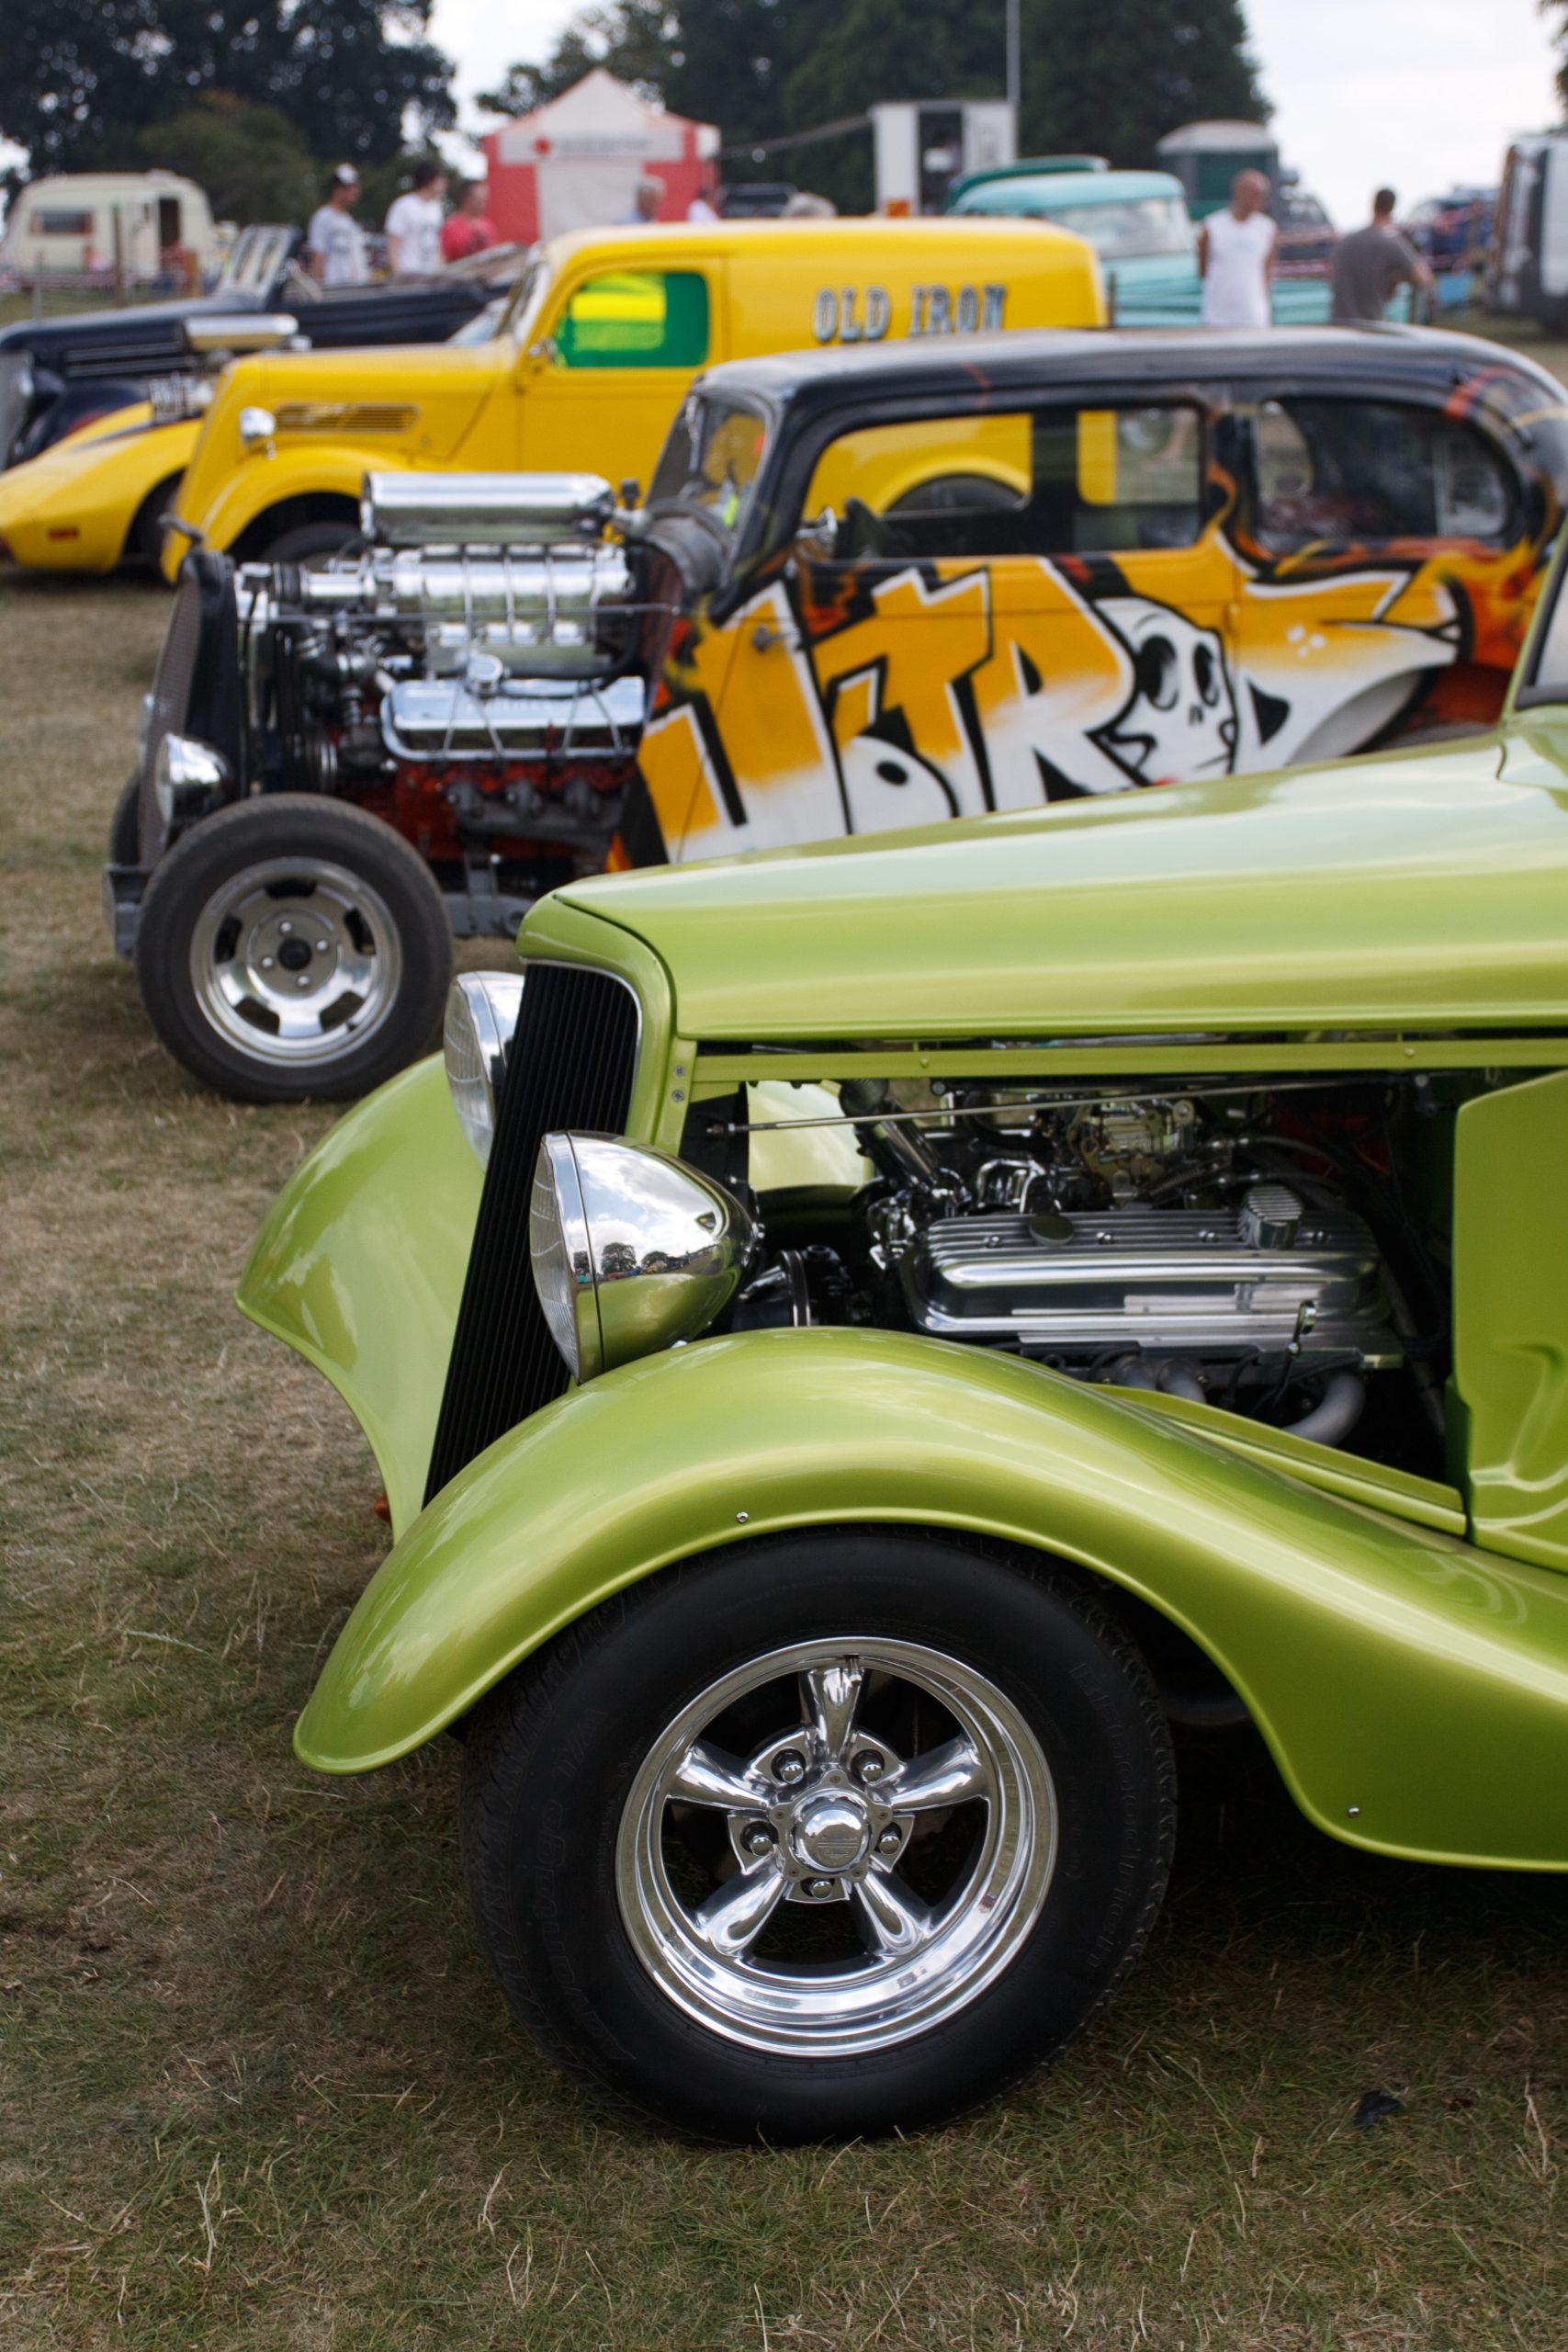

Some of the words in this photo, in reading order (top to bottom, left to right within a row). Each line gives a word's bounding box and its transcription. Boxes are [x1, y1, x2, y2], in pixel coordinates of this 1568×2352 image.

[812, 286, 890, 343] OLD
[908, 282, 1007, 338] IRON
[555, 1708, 611, 1779] T/A
[533, 1800, 637, 2060] Advantage
